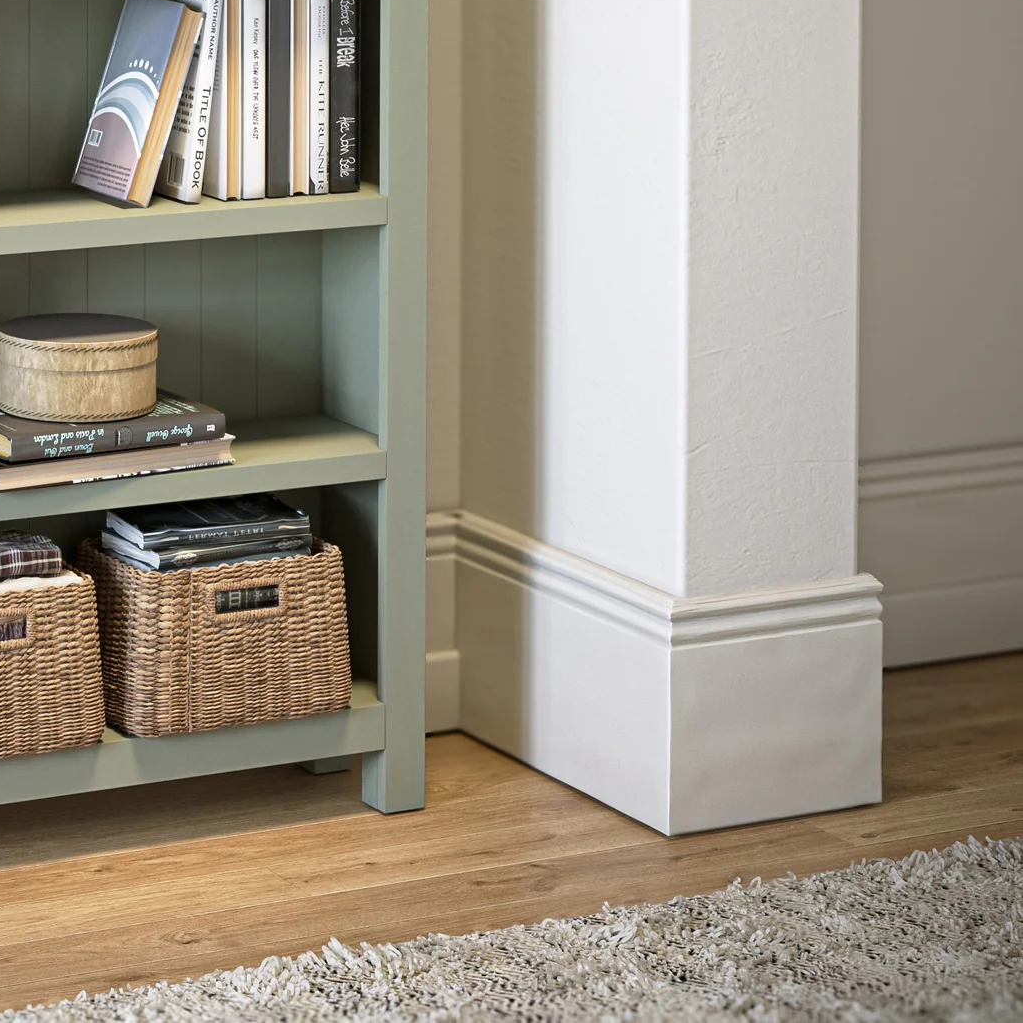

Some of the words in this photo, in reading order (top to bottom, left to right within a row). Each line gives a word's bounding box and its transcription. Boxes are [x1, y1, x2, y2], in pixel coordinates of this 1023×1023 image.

[210, 0, 219, 34] AUTHOR
[252, 29, 260, 44] Kesey
[339, 27, 354, 36] I
[208, 36, 217, 60] NAME
[199, 86, 212, 123] TITLE
[335, 116, 356, 134] Alec
[197, 127, 207, 147] OF
[339, 133, 356, 156] John
[317, 123, 325, 191] RUNNER
[191, 150, 204, 189] BOOK
[339, 156, 356, 178] Belle
[77, 429, 96, 441] Paris
[96, 428, 105, 437] in
[145, 429, 169, 442] Orwell
[170, 424, 194, 438] George
[33, 433, 60, 446] London
[60, 433, 74, 444] and
[44, 447, 57, 458] Out
[58, 445, 72, 457] and
[74, 443, 94, 454] Down
